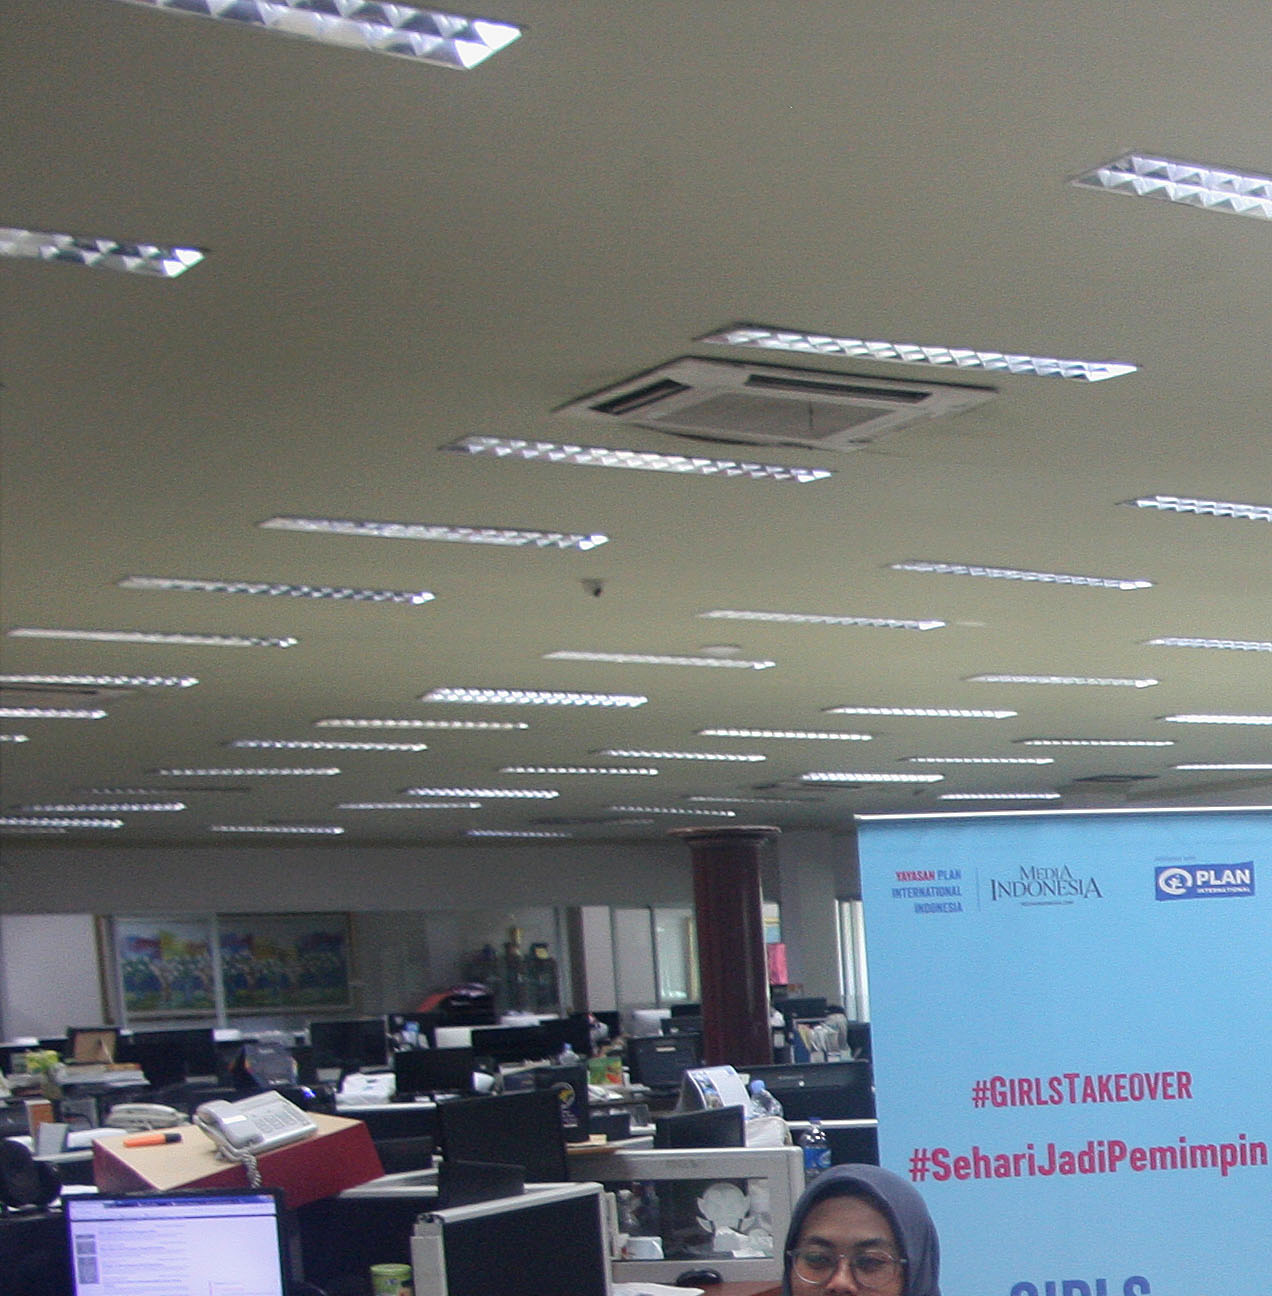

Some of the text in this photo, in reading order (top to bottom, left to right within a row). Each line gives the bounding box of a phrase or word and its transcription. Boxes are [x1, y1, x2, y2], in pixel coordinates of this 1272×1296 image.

[896, 869, 963, 882] YAYASAN PLAN
[1019, 864, 1073, 879] MEDIA
[1197, 868, 1251, 886] PLAN
[891, 884, 963, 898] INTERNATIONAL
[991, 875, 1103, 901] INDONESIA
[914, 901, 964, 914] INDONESIA
[908, 1133, 1269, 1183] #SehariJadiPemimpin
